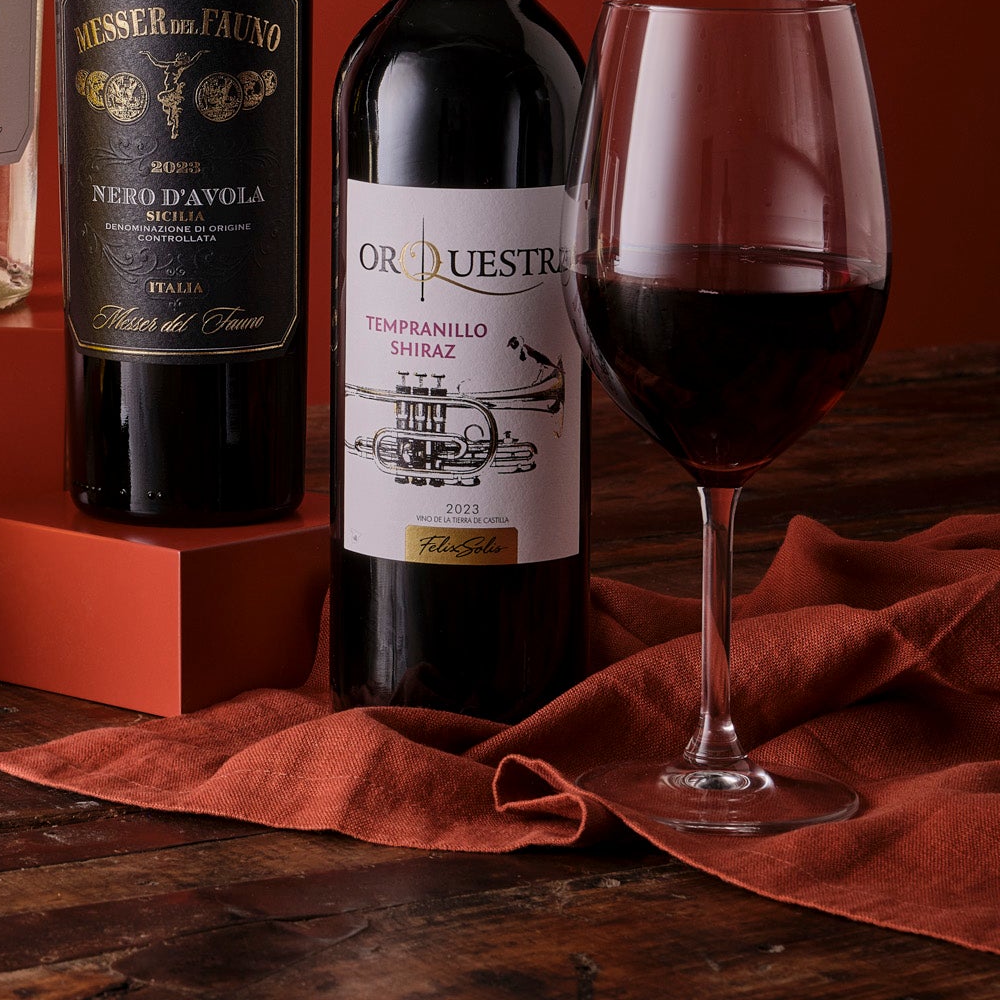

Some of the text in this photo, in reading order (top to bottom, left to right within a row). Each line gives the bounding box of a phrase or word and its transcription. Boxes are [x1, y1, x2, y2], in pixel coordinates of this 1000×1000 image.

[74, 6, 282, 54] MESSER DEL FAUNO
[150, 160, 201, 174] 2023
[92, 184, 265, 206] NERO D'AVOLA
[146, 210, 205, 222] SICILIA
[105, 222, 251, 233] DENOMINAZIONE DI ORIGINE
[137, 234, 217, 242] CONTROLLATA
[149, 281, 203, 294] ITALIA
[92, 304, 265, 335] Messer del Fauno
[366, 315, 488, 338] TEMPRANILLO
[390, 340, 456, 359] SHIRAZ
[446, 503, 479, 515] 2023
[452, 516, 472, 524] TIERRA
[473, 516, 482, 524] DE
[483, 516, 509, 524] CASTILLA
